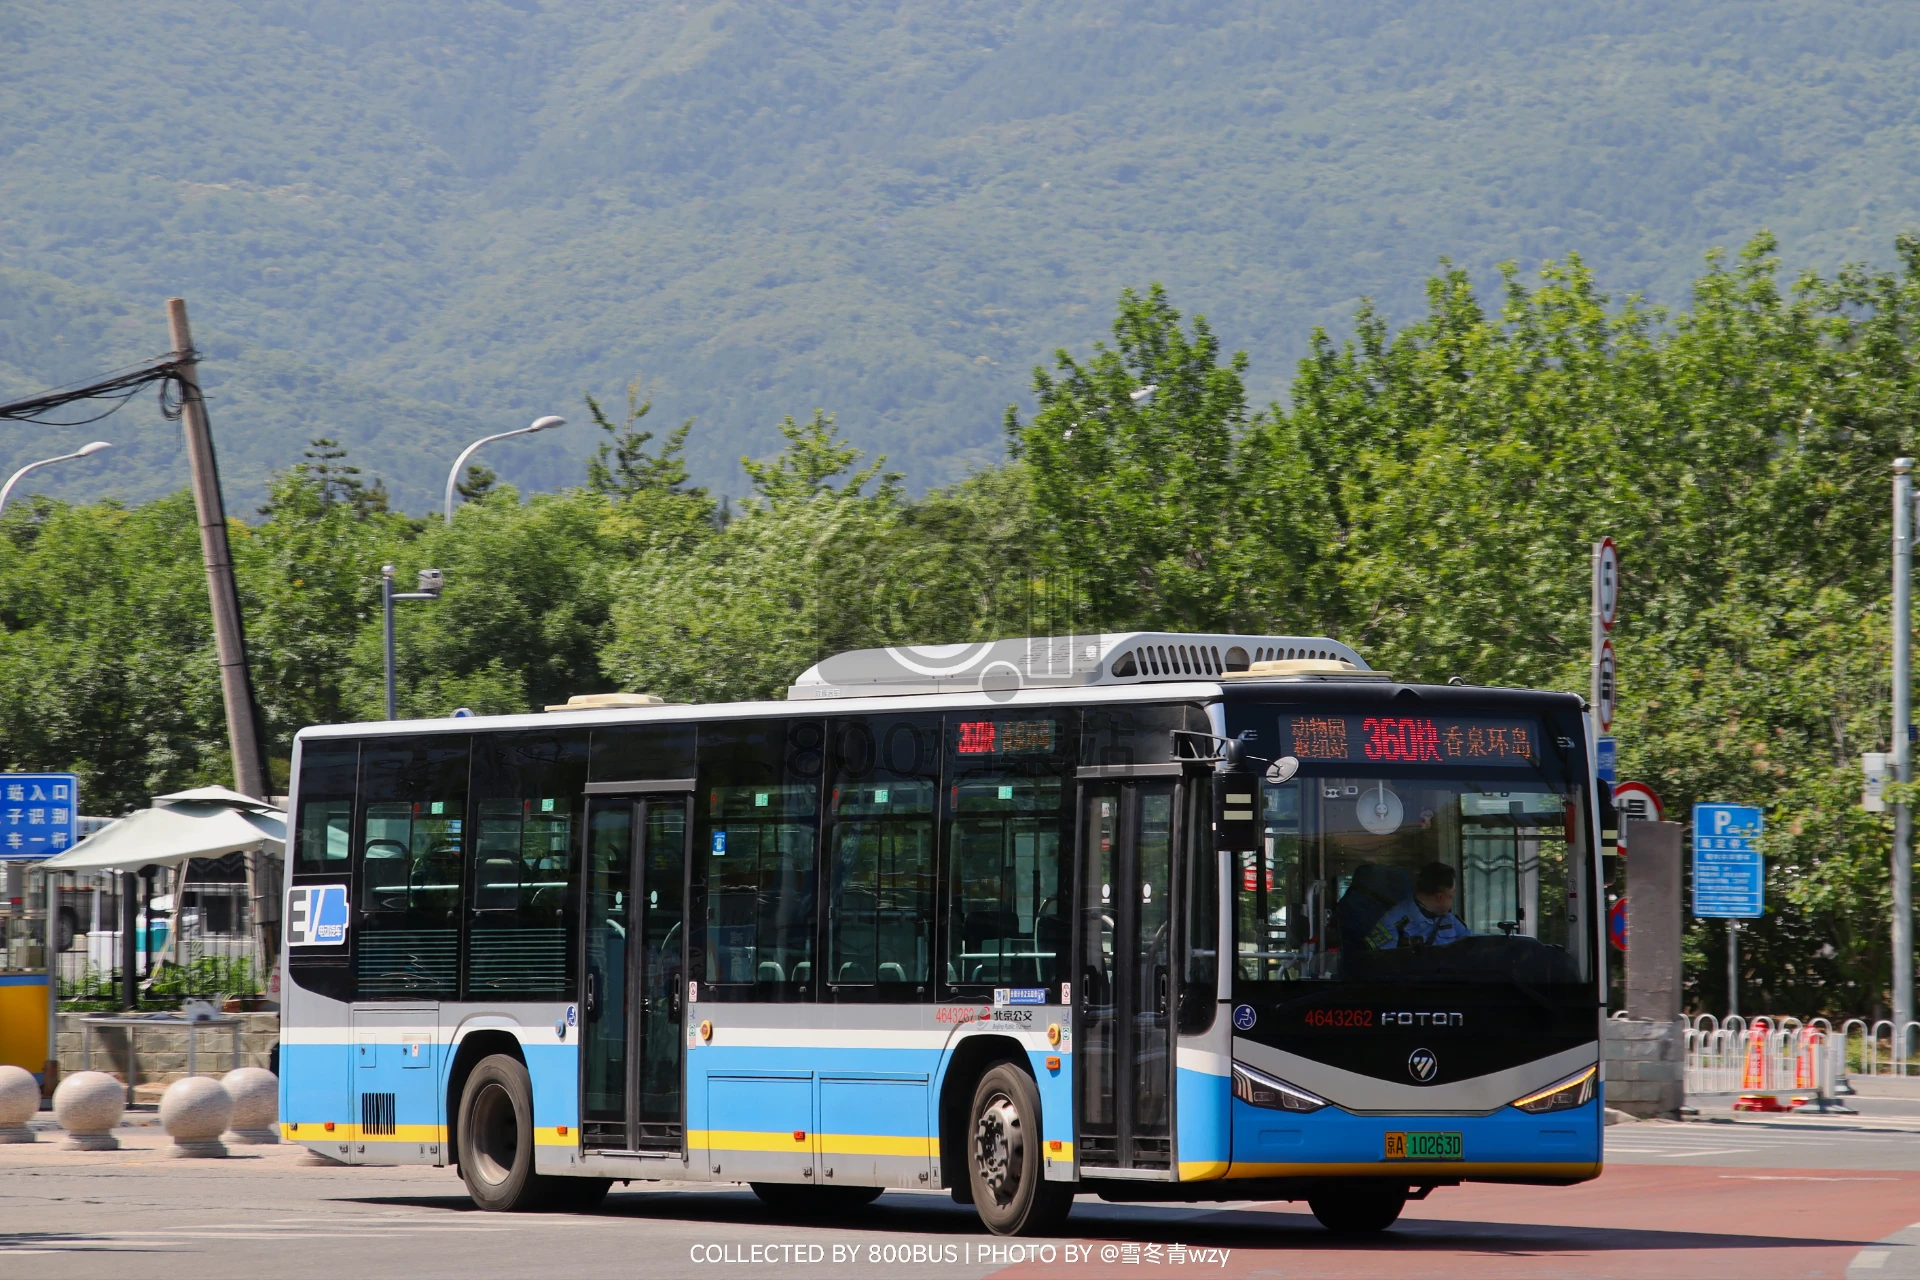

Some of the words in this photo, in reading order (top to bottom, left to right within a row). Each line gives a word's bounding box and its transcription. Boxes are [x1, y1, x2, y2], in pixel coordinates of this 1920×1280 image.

[1291, 717, 1346, 739] 动物园
[1363, 718, 1443, 761] 360快
[1442, 725, 1532, 760] 香泉环岛
[1293, 739, 1349, 759] 枢纽站
[0, 784, 69, 801] 站入口
[0, 808, 69, 825] 子识别
[1714, 810, 1732, 834] P
[936, 1007, 975, 1023] 4643262
[994, 1010, 1033, 1022] 北京公交
[1305, 1010, 1373, 1026] 4643262
[1381, 1012, 1464, 1026] FOTON
